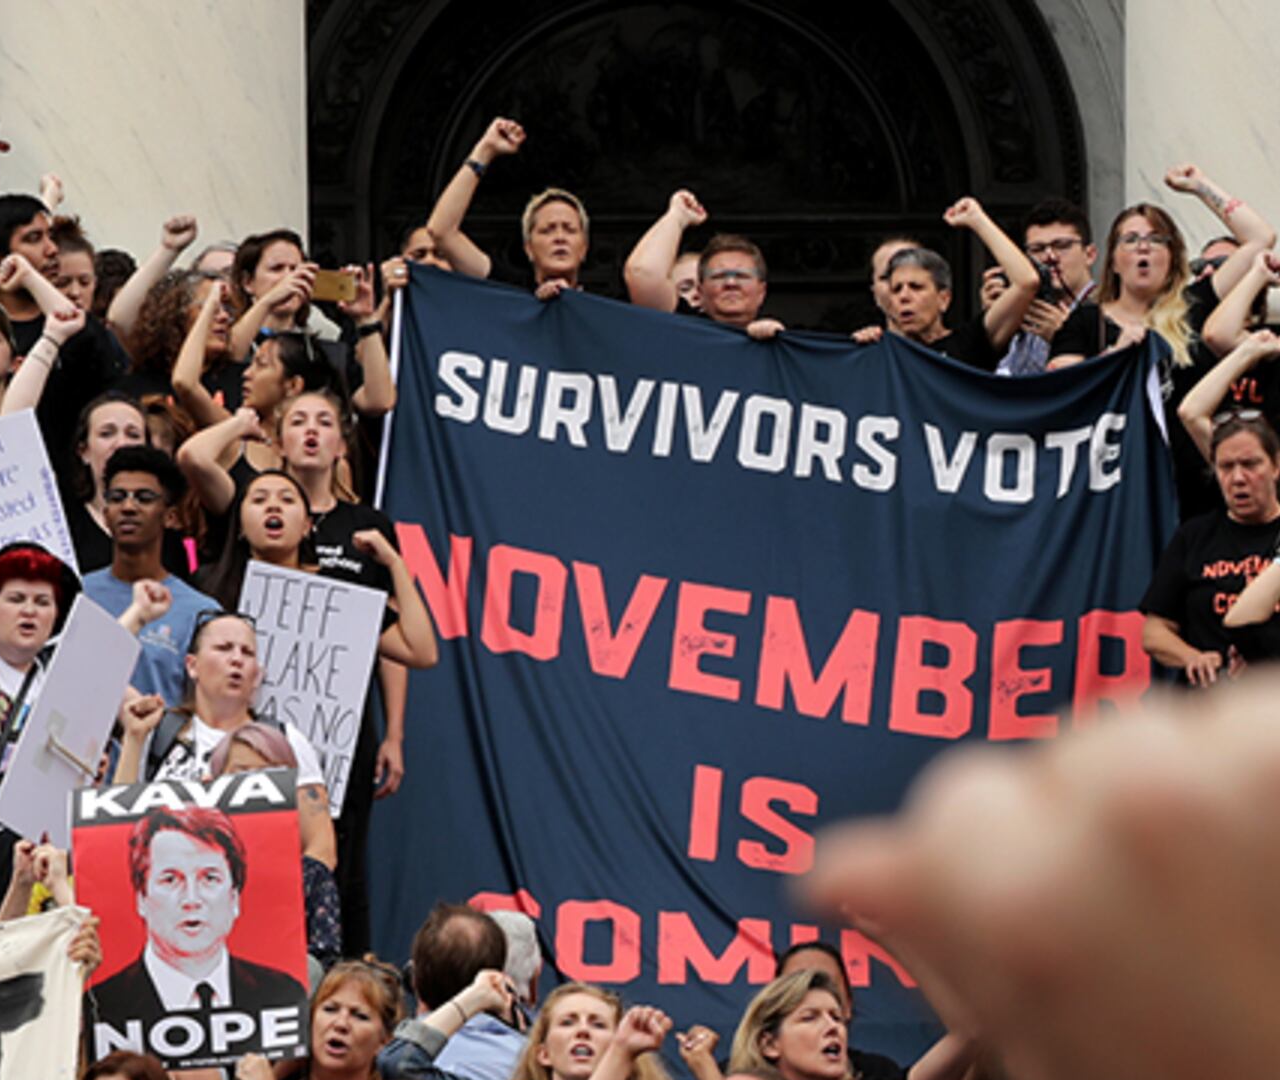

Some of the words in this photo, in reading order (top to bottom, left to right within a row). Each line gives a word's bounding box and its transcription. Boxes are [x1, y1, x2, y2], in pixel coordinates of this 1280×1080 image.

[434, 350, 901, 492] SURVIVORS
[923, 412, 1126, 503] VOTE
[247, 571, 350, 638] JEFF
[394, 521, 1152, 740] NOVEMBER
[309, 704, 356, 751] NO
[80, 771, 286, 820] KAVA
[687, 765, 819, 875] IS
[93, 1006, 301, 1061] NOPE
